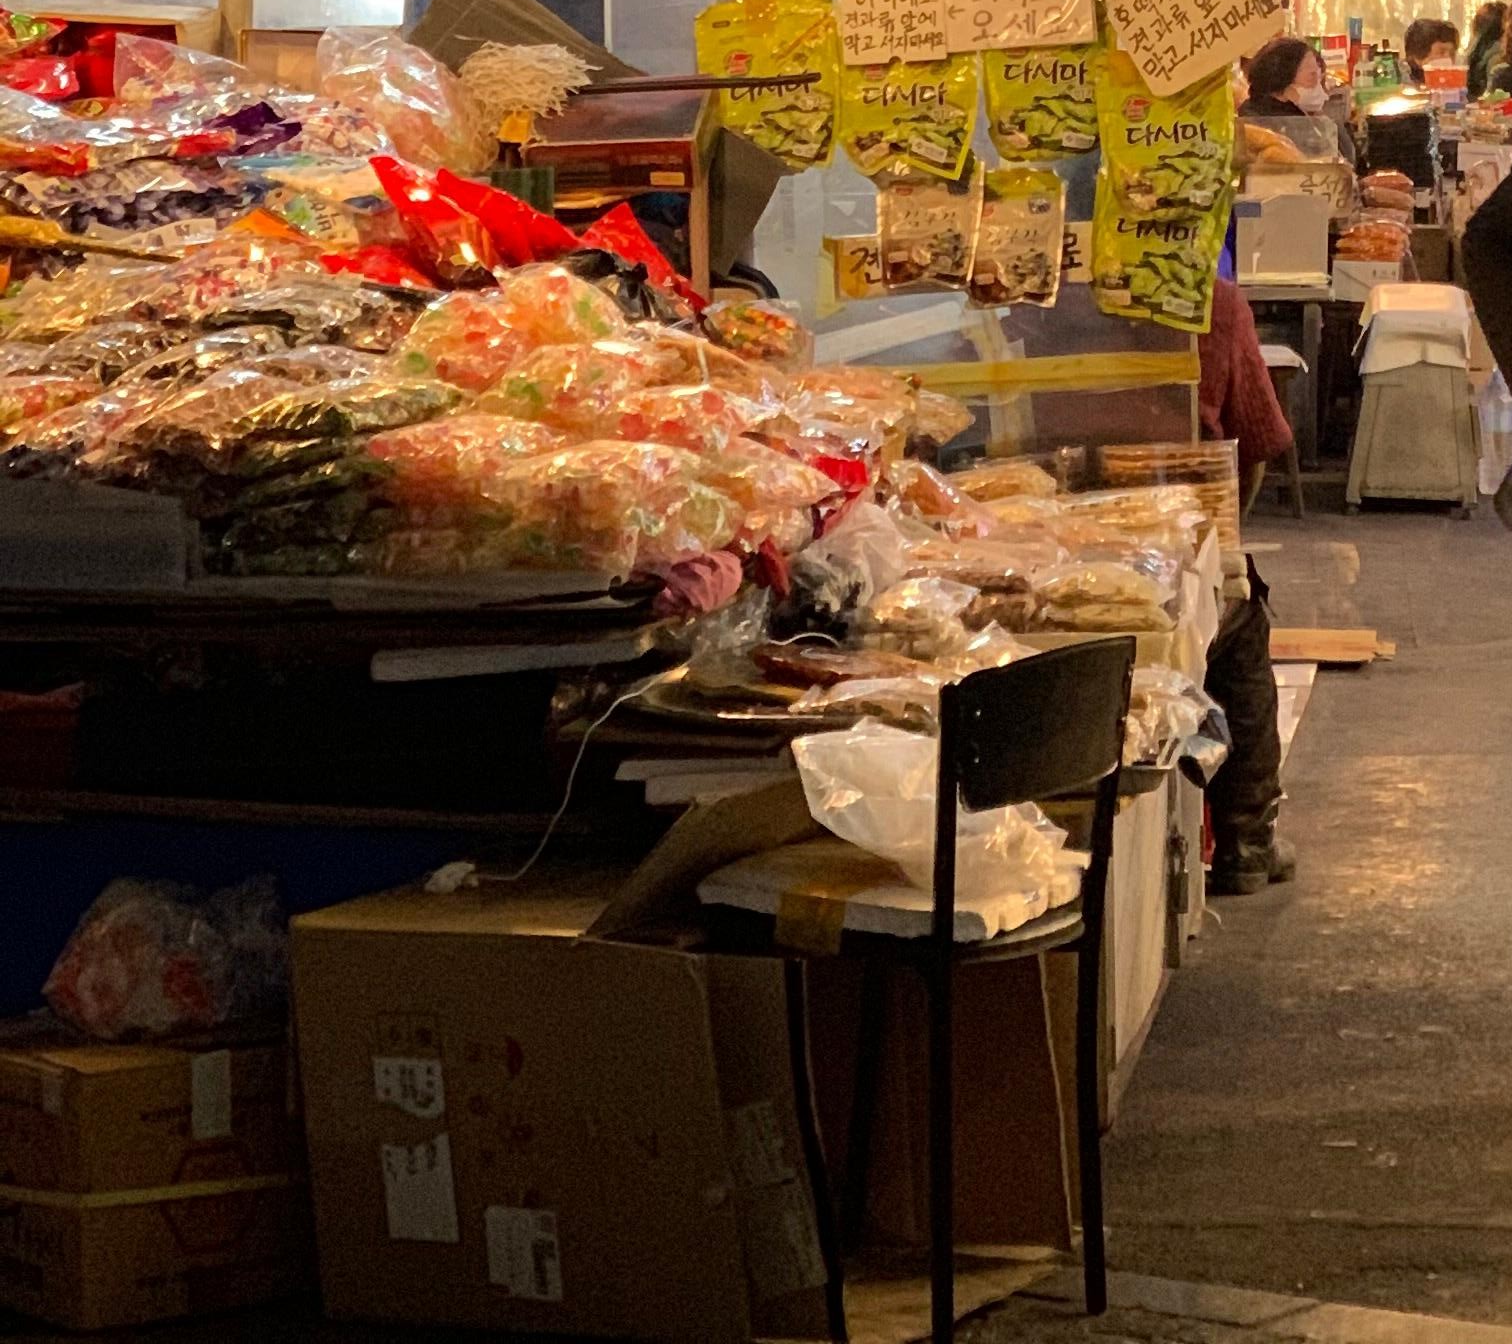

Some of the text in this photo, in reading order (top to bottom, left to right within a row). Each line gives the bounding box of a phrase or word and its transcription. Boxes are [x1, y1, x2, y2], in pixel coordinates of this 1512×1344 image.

[845, 11, 895, 34] 견과류
[1128, 3, 1191, 54] 견과류
[844, 34, 878, 55] 막고
[1004, 58, 1089, 85] 다시마
[1142, 45, 1188, 82] 막고
[1126, 121, 1209, 147] 다시마
